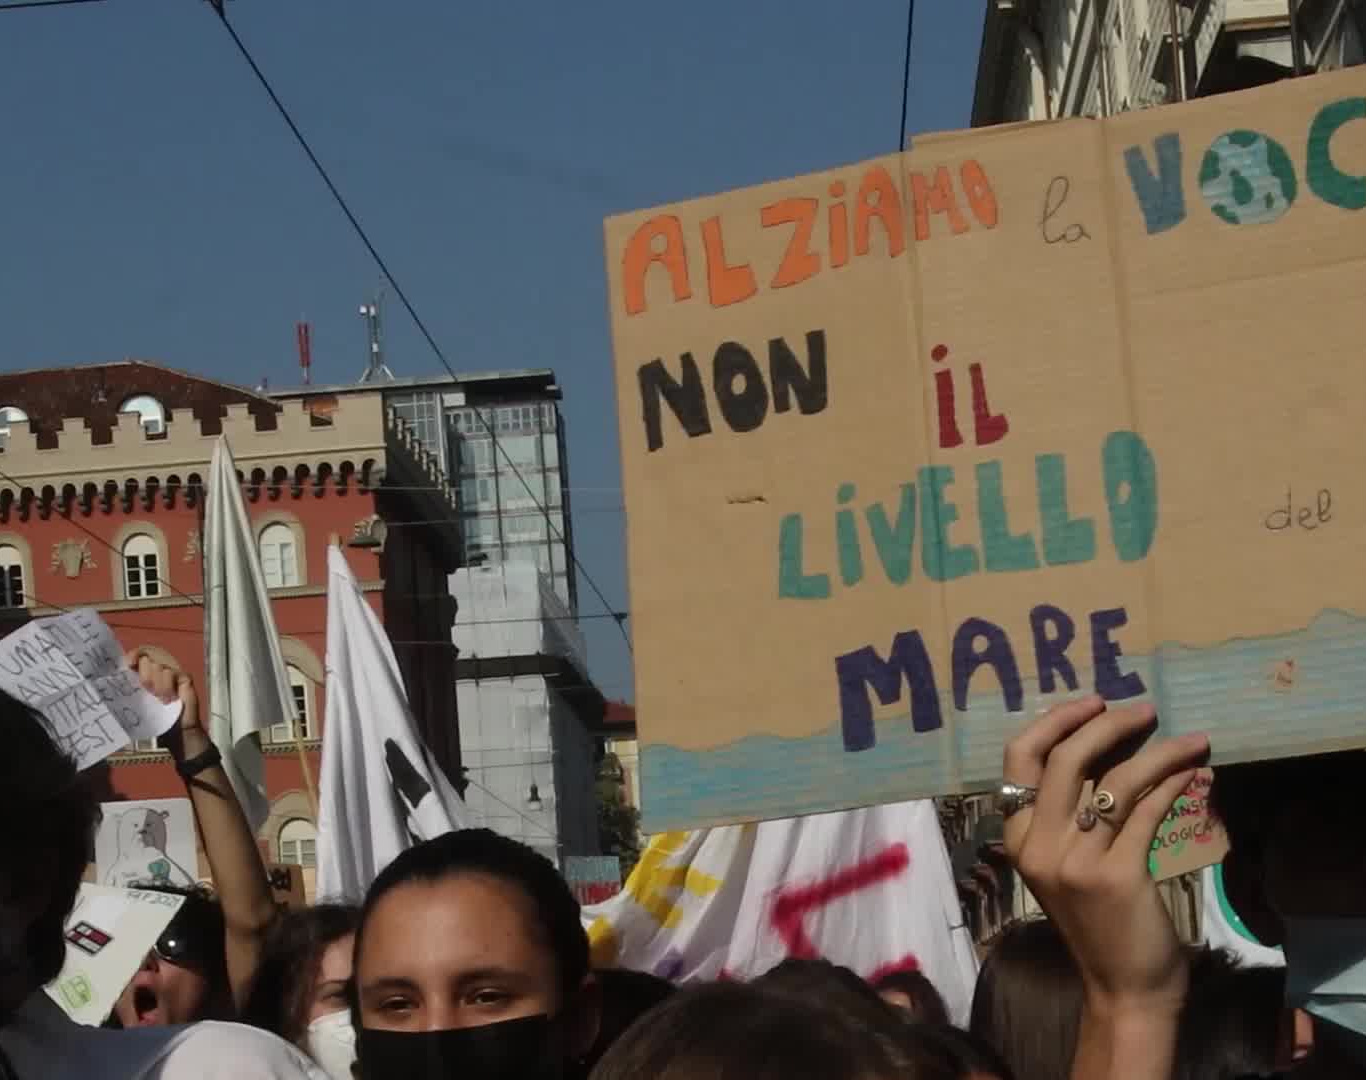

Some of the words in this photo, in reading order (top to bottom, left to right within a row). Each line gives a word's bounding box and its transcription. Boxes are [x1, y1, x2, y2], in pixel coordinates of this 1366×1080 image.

[1039, 172, 1094, 247] la
[636, 328, 830, 454] NON
[1263, 486, 1335, 534] del
[834, 602, 1148, 754] MARE
